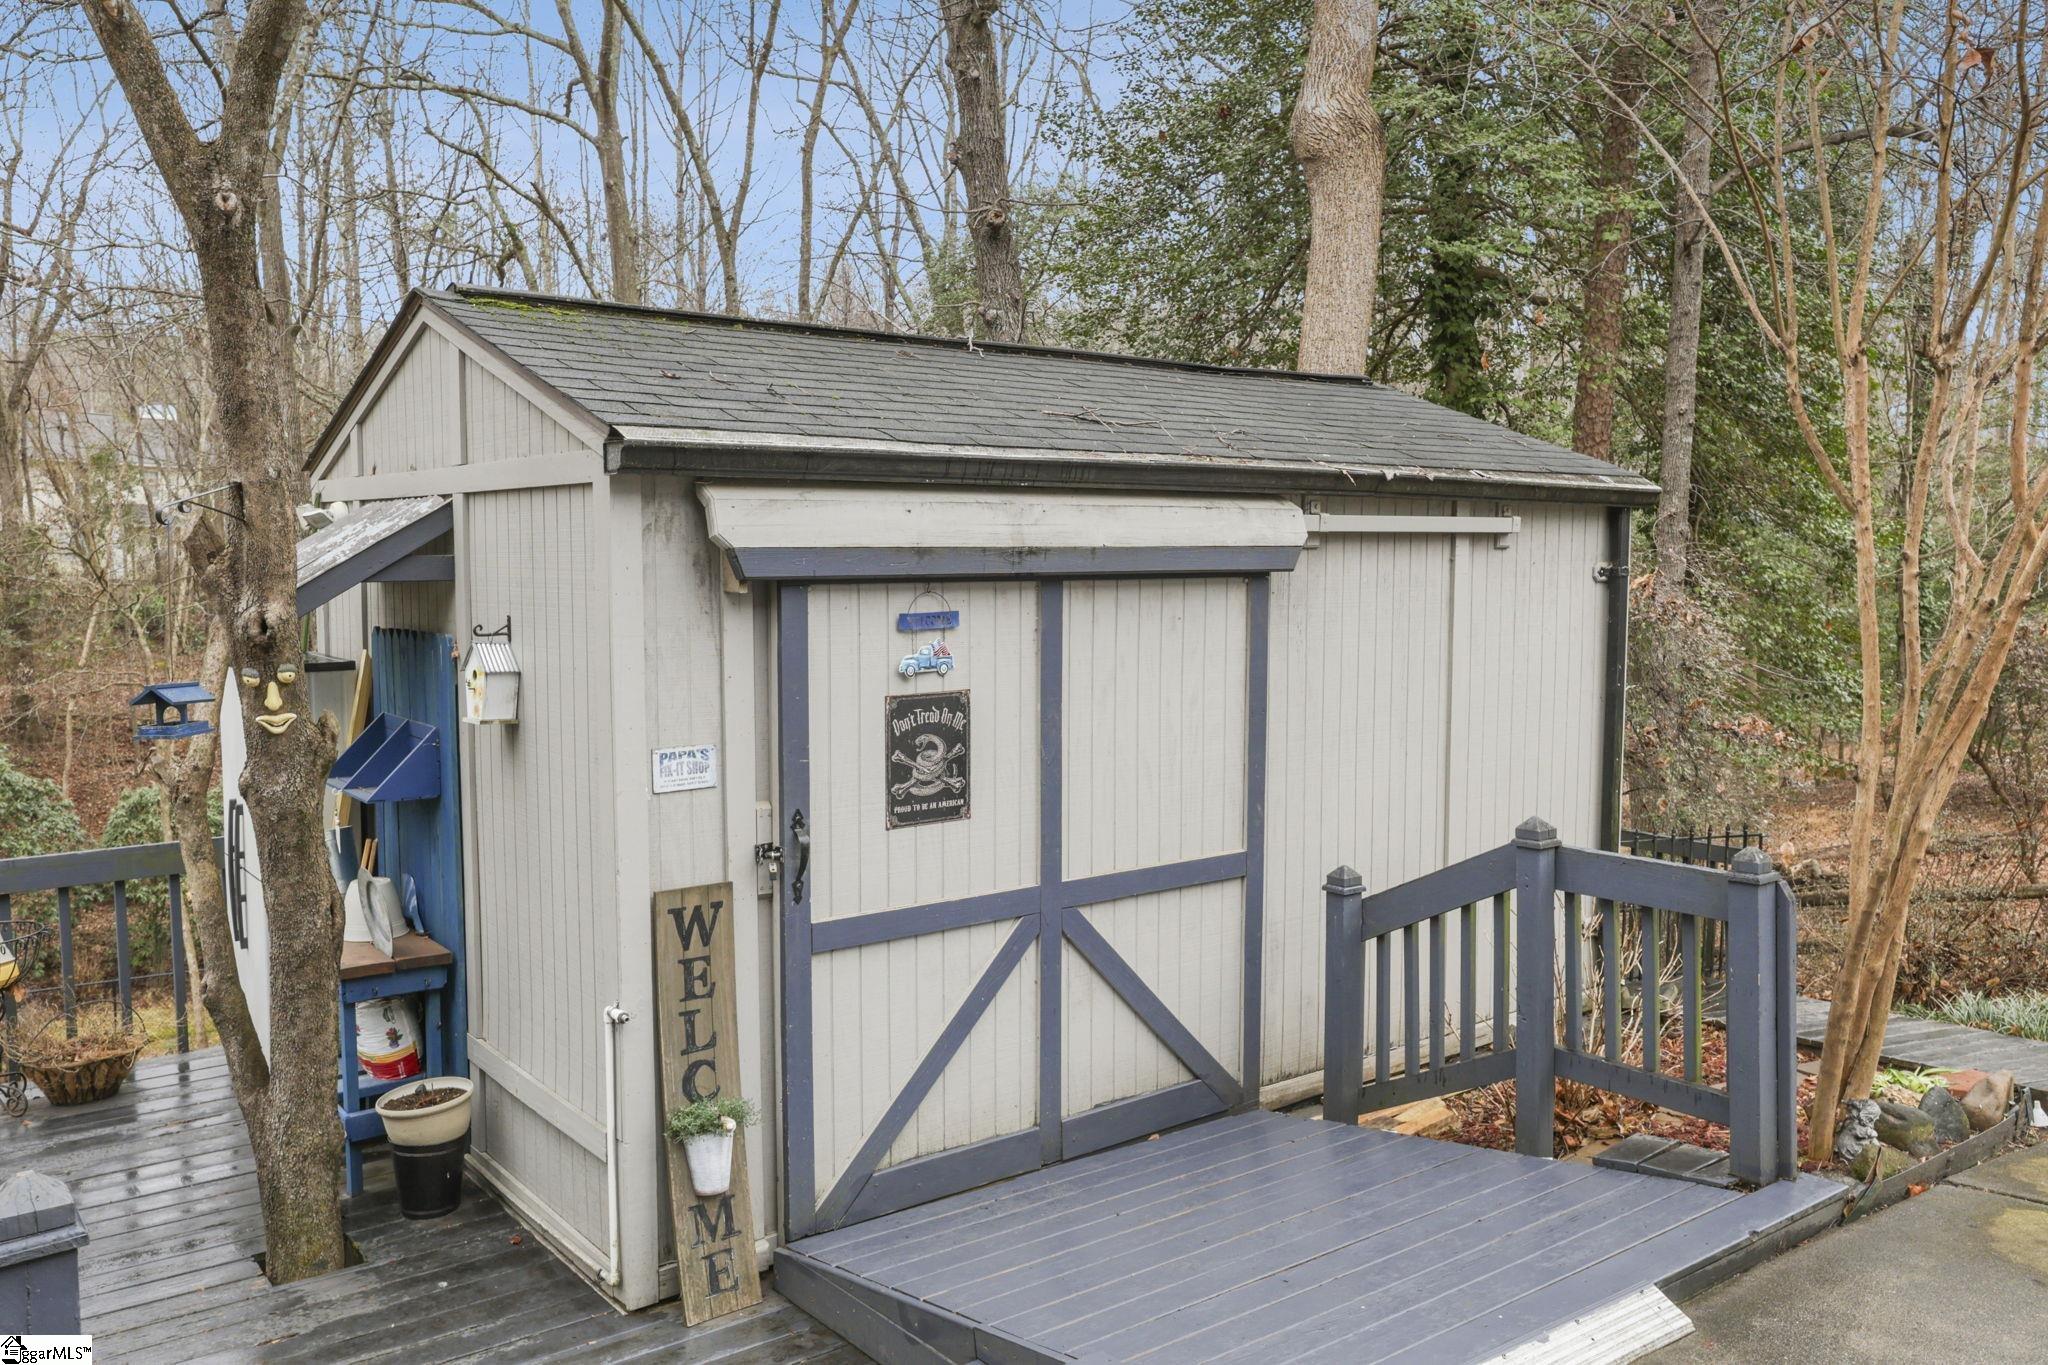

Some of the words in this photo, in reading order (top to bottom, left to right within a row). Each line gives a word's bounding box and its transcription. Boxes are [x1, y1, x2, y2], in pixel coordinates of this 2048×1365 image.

[892, 713, 916, 736] Don't
[913, 706, 940, 725] Tread
[941, 707, 953, 727] On
[952, 711, 967, 731] Me
[659, 748, 709, 765] PAPA'S
[660, 761, 685, 777] FIX-IT
[687, 761, 709, 775] SHOP
[894, 805, 912, 814] PROUD
[938, 799, 964, 808] AMERICAN
[667, 900, 742, 1299] WELCME
